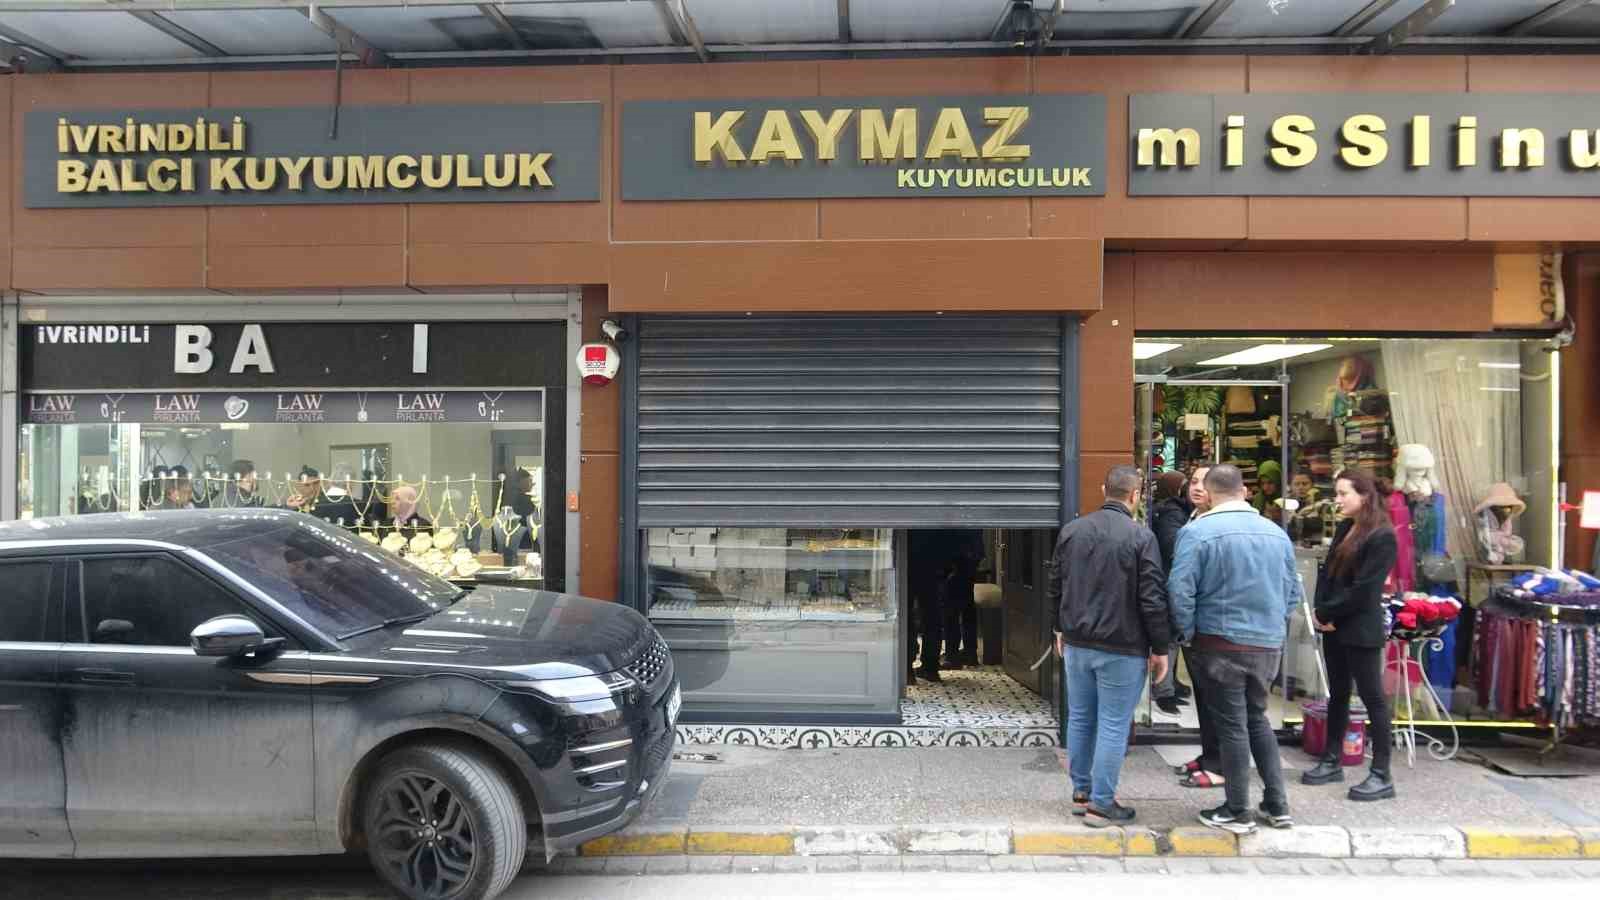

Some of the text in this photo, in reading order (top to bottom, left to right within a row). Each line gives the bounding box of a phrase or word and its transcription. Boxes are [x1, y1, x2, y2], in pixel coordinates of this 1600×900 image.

[57, 116, 245, 153] İVRİNDİLİ
[694, 106, 1031, 163] KAYMAZ
[56, 152, 553, 193] BALCI KUYUMCULUK
[897, 167, 1092, 189] KUYUMCULUK
[31, 395, 75, 411] LAW
[153, 394, 201, 410] LAW
[276, 394, 324, 410] LAW
[397, 393, 446, 410] LAW
[275, 413, 325, 422] PIRLANTA
[396, 412, 446, 421] PIRLANTA
